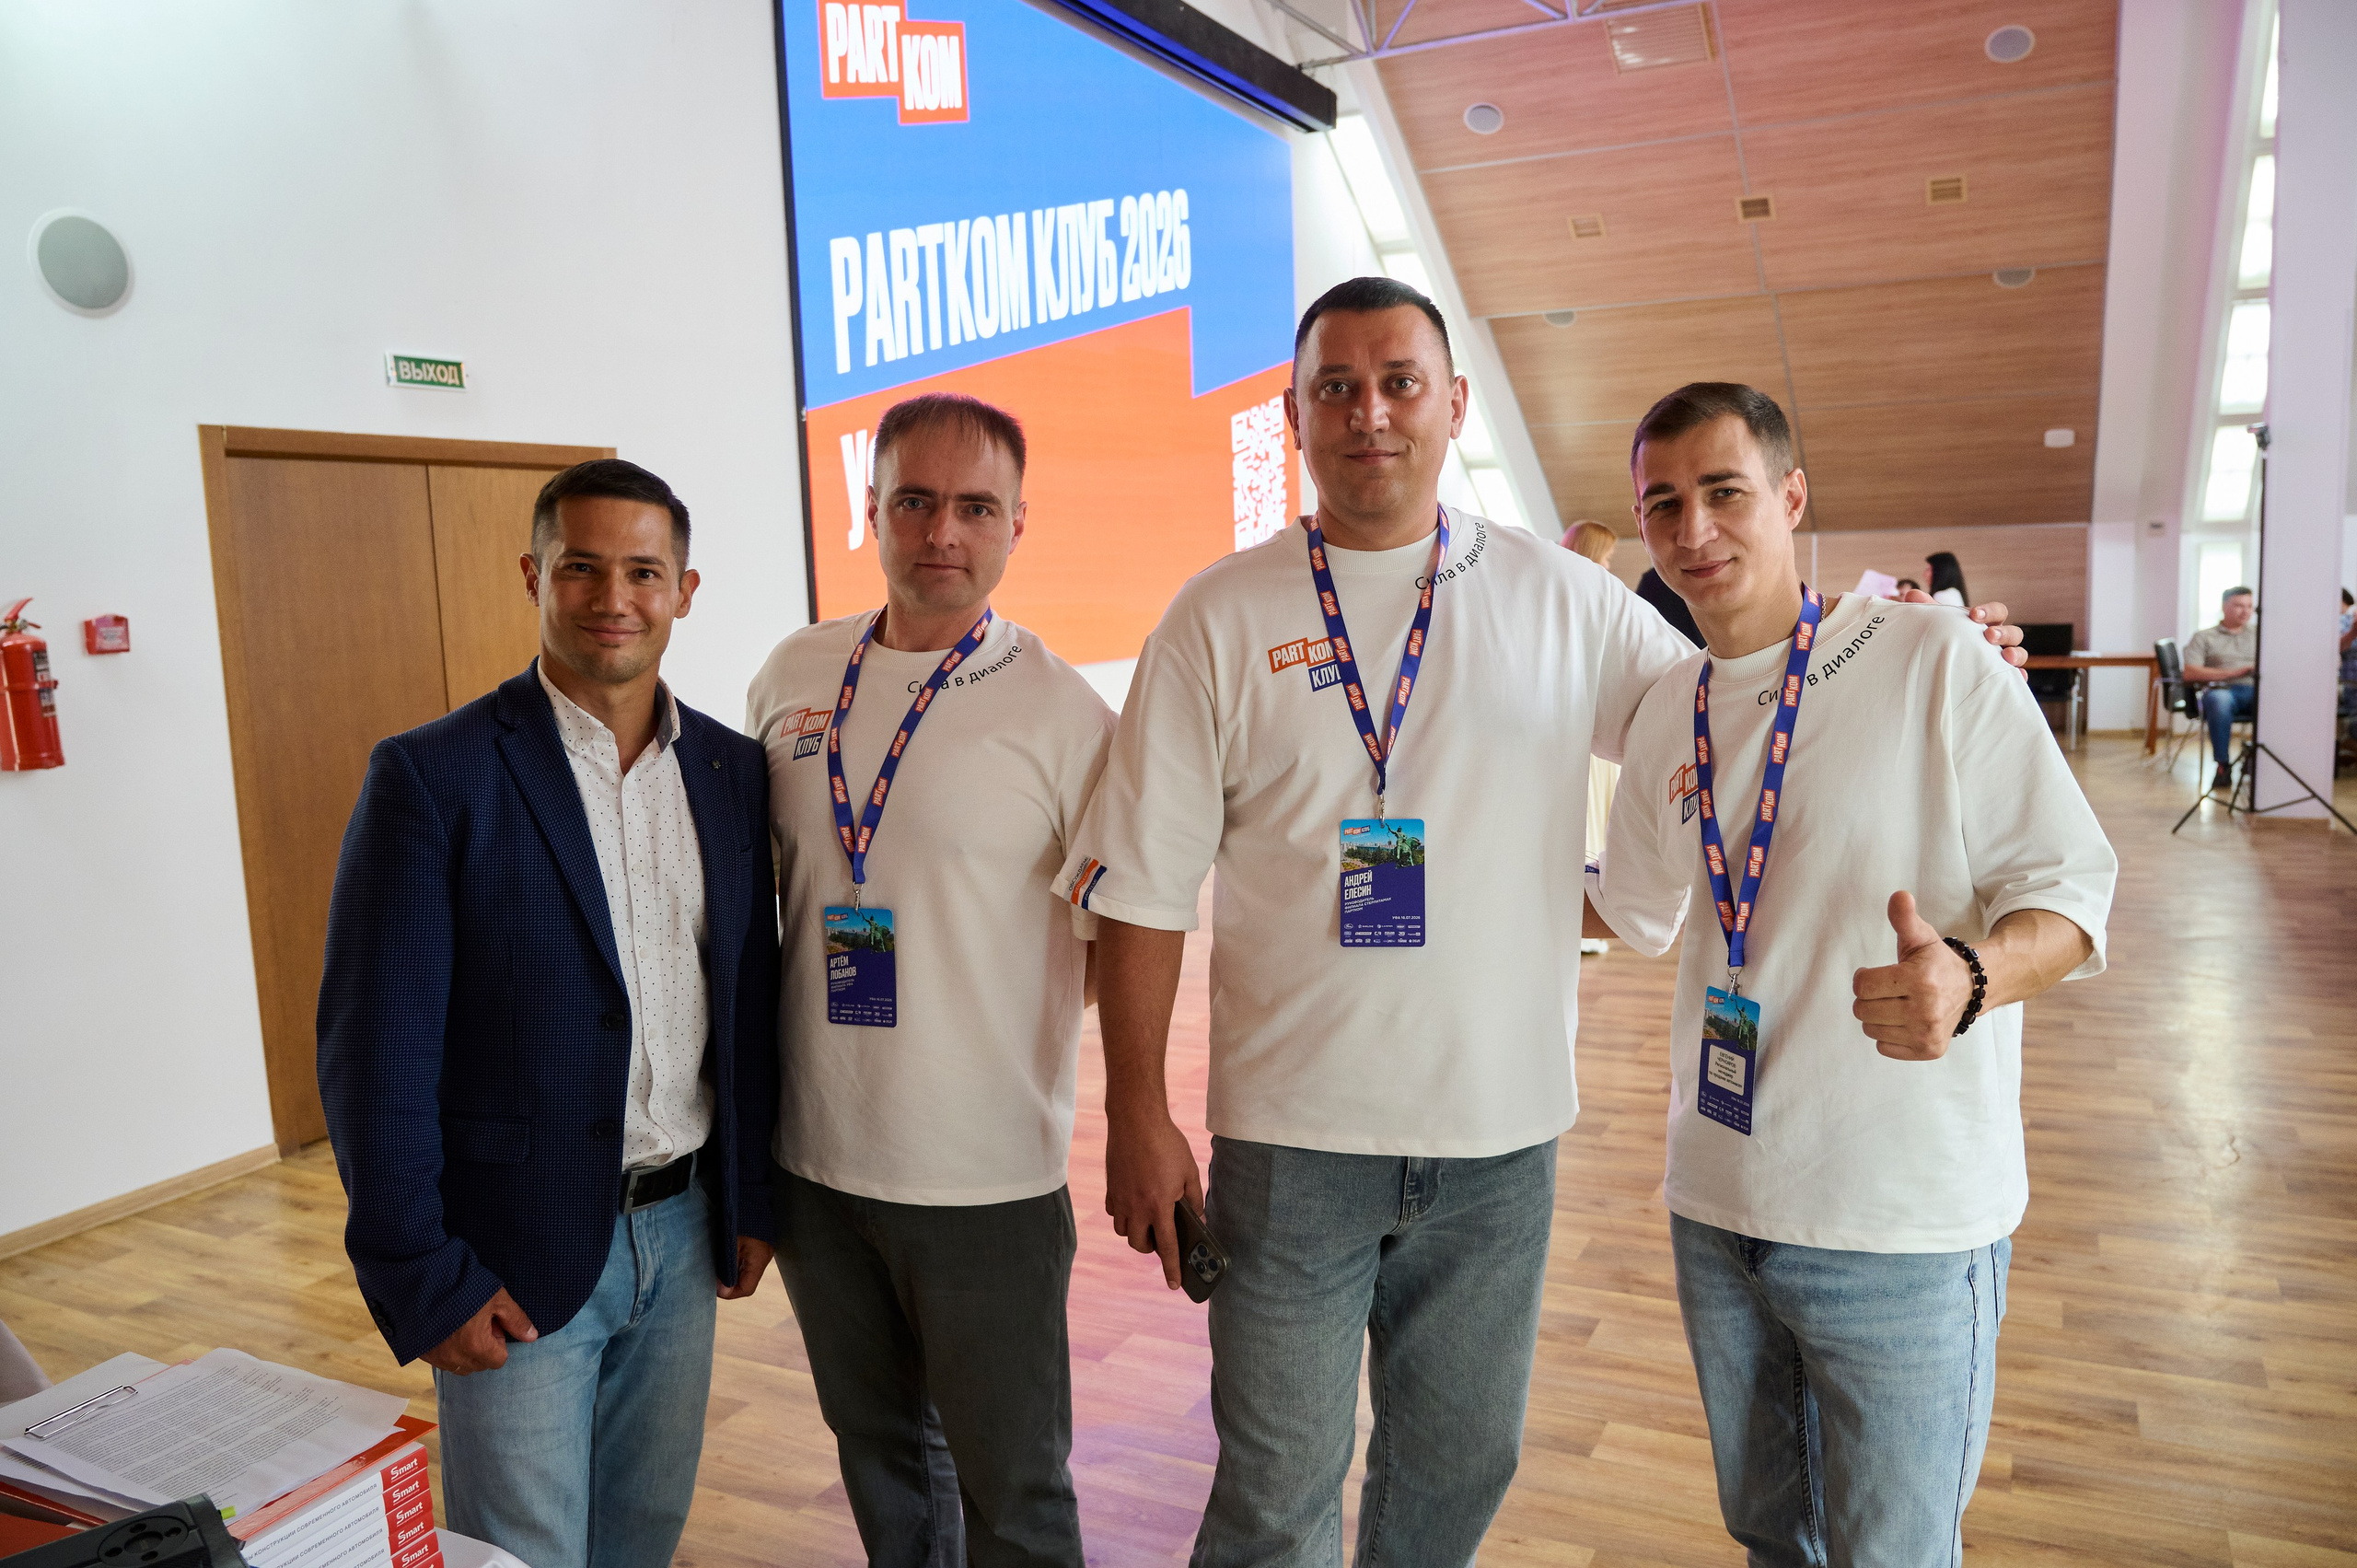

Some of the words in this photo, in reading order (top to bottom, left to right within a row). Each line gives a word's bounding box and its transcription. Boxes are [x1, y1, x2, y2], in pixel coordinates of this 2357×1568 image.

[826, 5, 899, 83] PART
[902, 35, 962, 110] KOM
[830, 212, 1029, 374] PARTKOM
[1032, 199, 1118, 323] КЛУБ
[1120, 189, 1191, 303] 2026
[399, 360, 460, 386] ВЫХОД
[1456, 562, 1466, 573] в
[1465, 522, 1487, 566] диалоге
[1798, 633, 1808, 649] PART
[1806, 672, 1818, 687] в
[1822, 614, 1885, 680] диалоге
[1271, 642, 1305, 669] PART
[907, 679, 949, 693] Са
[955, 677, 965, 687] в
[969, 645, 1023, 684] диалоге
[1789, 676, 1798, 691] KOM
[1786, 689, 1795, 706] PART
[802, 713, 830, 733] KOM
[795, 736, 822, 757] КЛУБ
[1777, 732, 1786, 748] KOM
[1773, 746, 1783, 762] PART
[1685, 767, 1698, 793] KO
[1765, 790, 1774, 806] KOM
[1762, 803, 1771, 820] PART
[1707, 845, 1722, 860] PART
[1753, 847, 1763, 862] KOM
[1711, 860, 1724, 874] KOM
[1750, 859, 1759, 877] PART
[1344, 870, 1373, 888] АНДРЕЙ
[1344, 885, 1372, 900] ЕЛЕСИН
[1740, 903, 1748, 917] KOM
[1737, 915, 1746, 931] PART
[830, 956, 849, 969] АРТЁМ
[830, 967, 857, 981] ЛОБАНОВ
[390, 1458, 418, 1481] Smart
[392, 1480, 420, 1504] Smart
[254, 1530, 296, 1557] КОНСТРУКЦИИ
[296, 1504, 342, 1533] СОВРЕМЕННОГО
[342, 1483, 377, 1507] АВТОМОБИЛЯ
[396, 1501, 424, 1525] Smart
[299, 1528, 344, 1558] СОВРЕМЕННОГО
[344, 1506, 379, 1531] АВТОМОБИЛЯ
[348, 1528, 383, 1553] АВТОМОБИЛЯ
[398, 1521, 424, 1545] Smart
[401, 1544, 429, 1568] Smart
